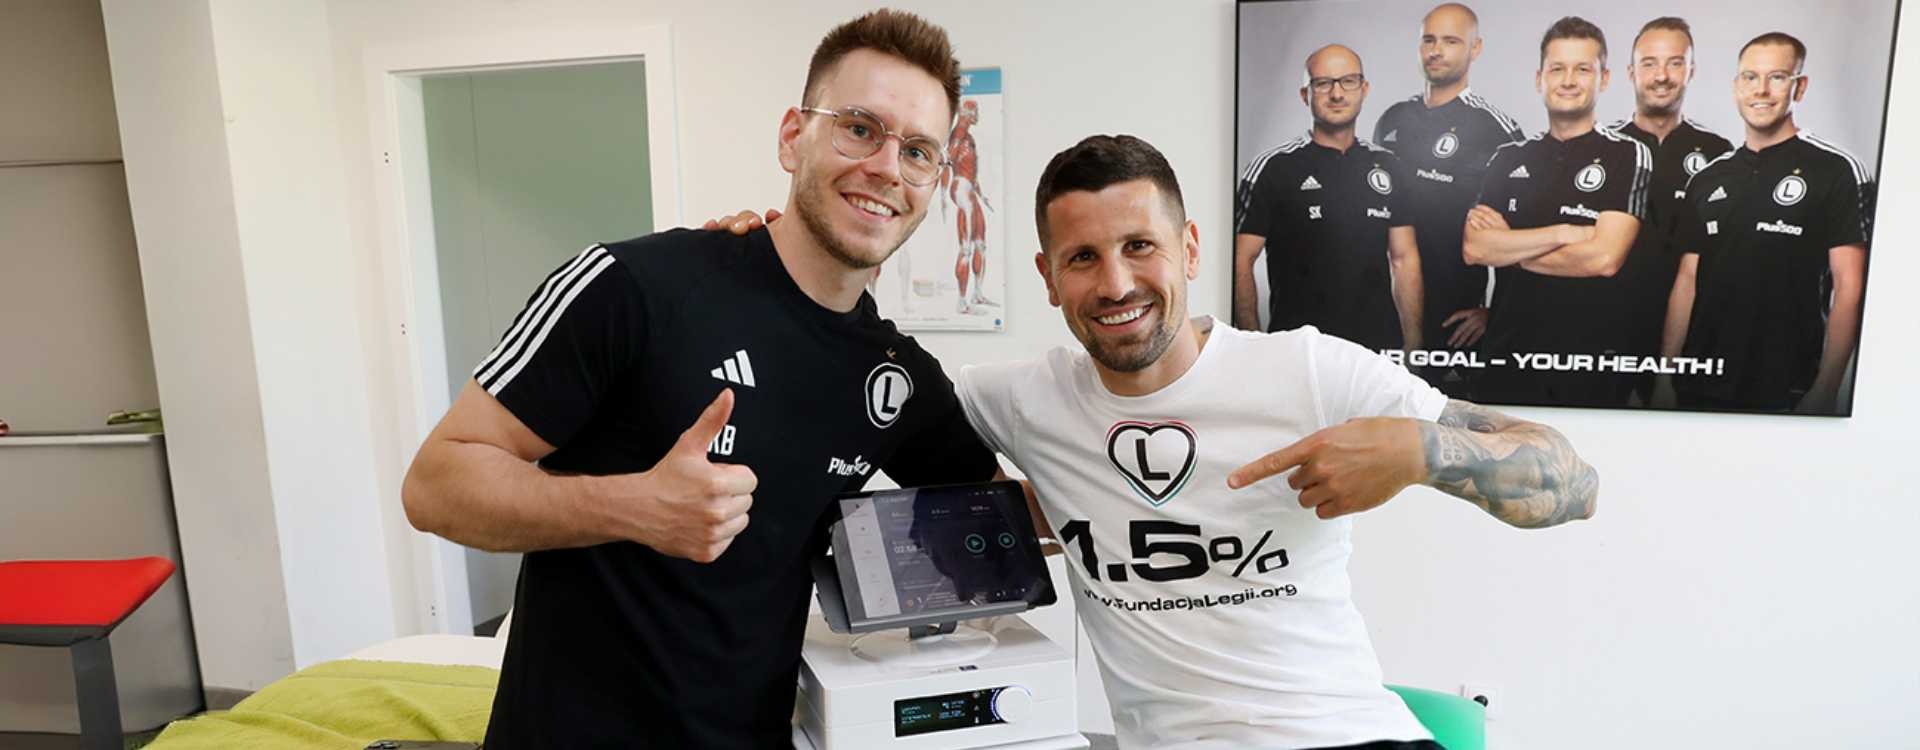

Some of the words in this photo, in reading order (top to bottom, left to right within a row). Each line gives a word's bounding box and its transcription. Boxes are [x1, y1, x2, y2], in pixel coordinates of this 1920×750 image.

[1409, 349, 1486, 368] GOAL
[1512, 352, 1594, 371] YOUR
[1135, 438, 1171, 481] L
[1059, 519, 1290, 582] 1.5%
[1083, 584, 1298, 611] ww.FundacjaLegii.org
